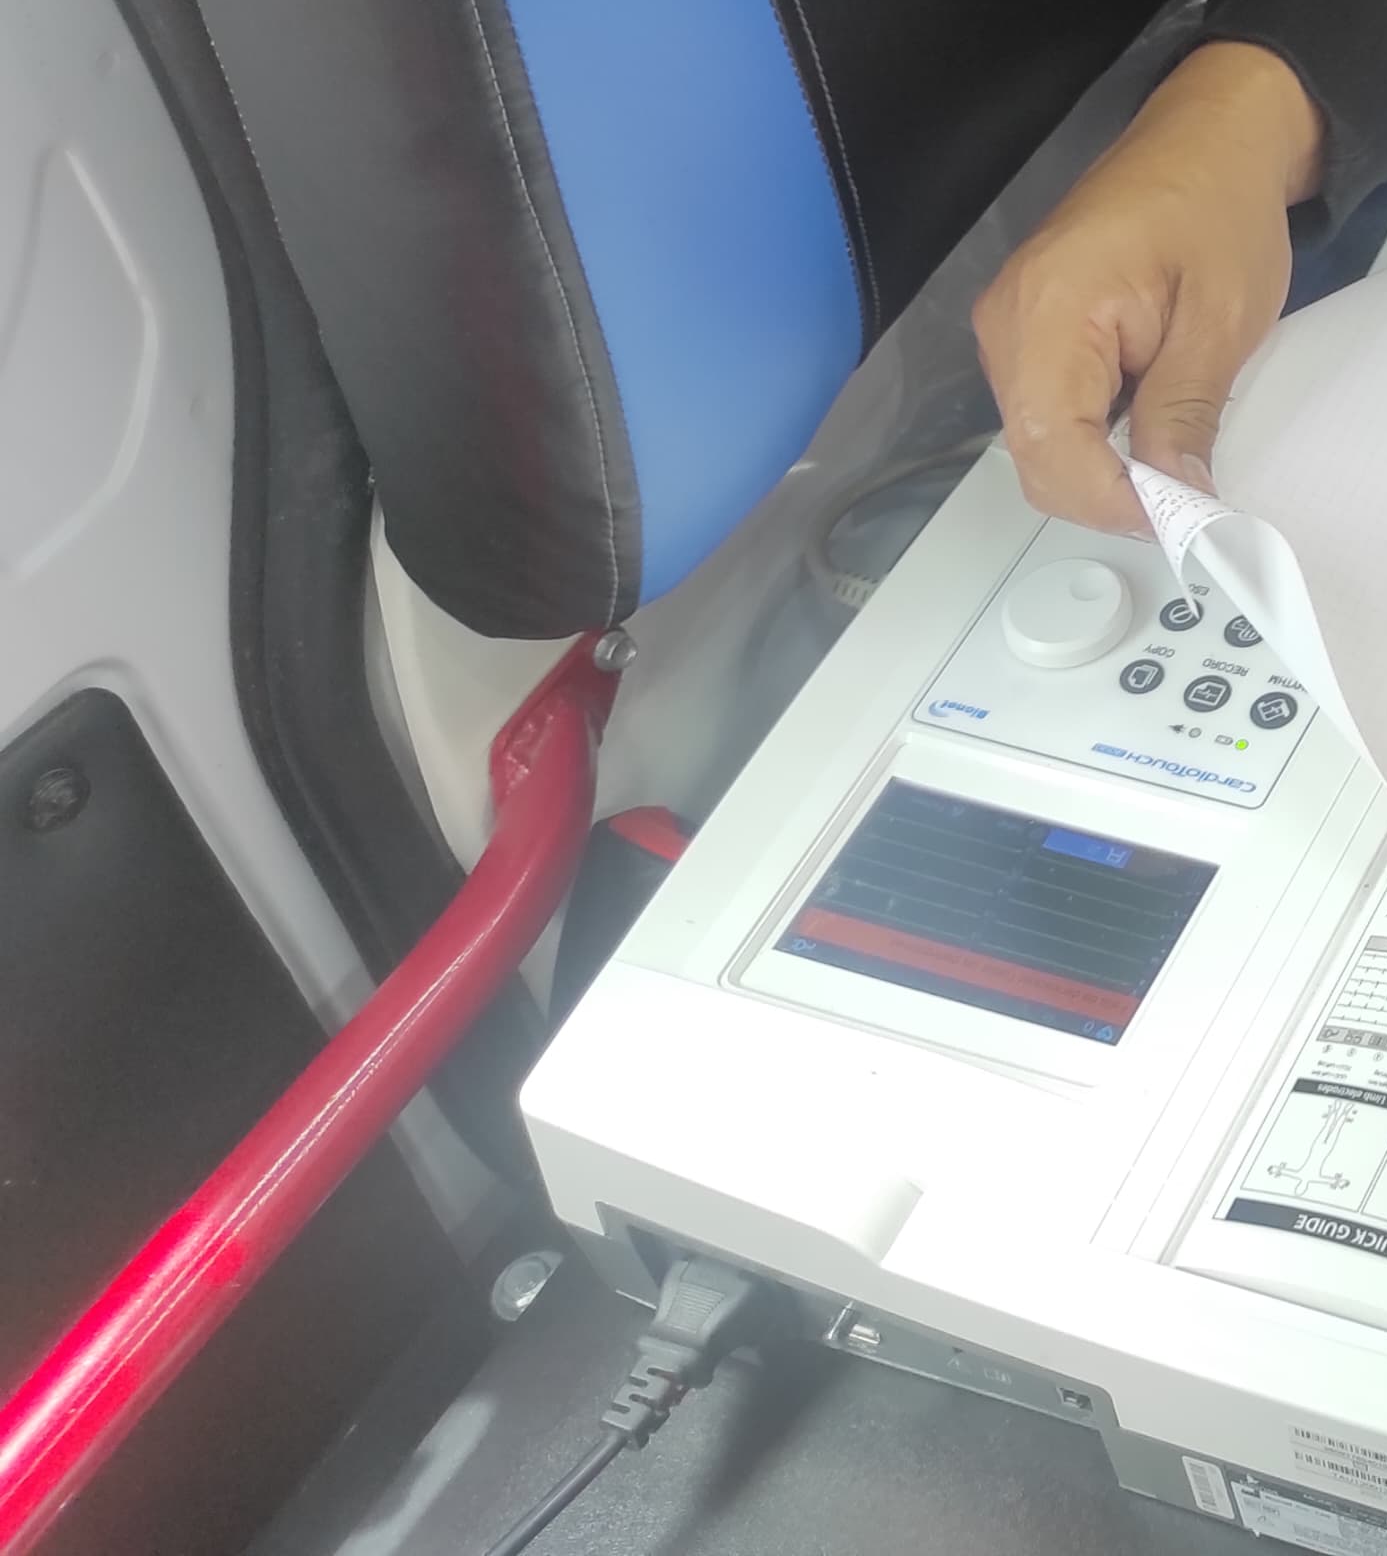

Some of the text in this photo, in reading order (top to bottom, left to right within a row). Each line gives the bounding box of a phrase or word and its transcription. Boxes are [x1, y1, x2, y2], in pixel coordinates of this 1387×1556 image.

[1143, 644, 1175, 658] COPY
[1202, 657, 1250, 677] RECORD
[1363, 1092, 1387, 1106] Limb
[1293, 1213, 1350, 1240] GUIDE
